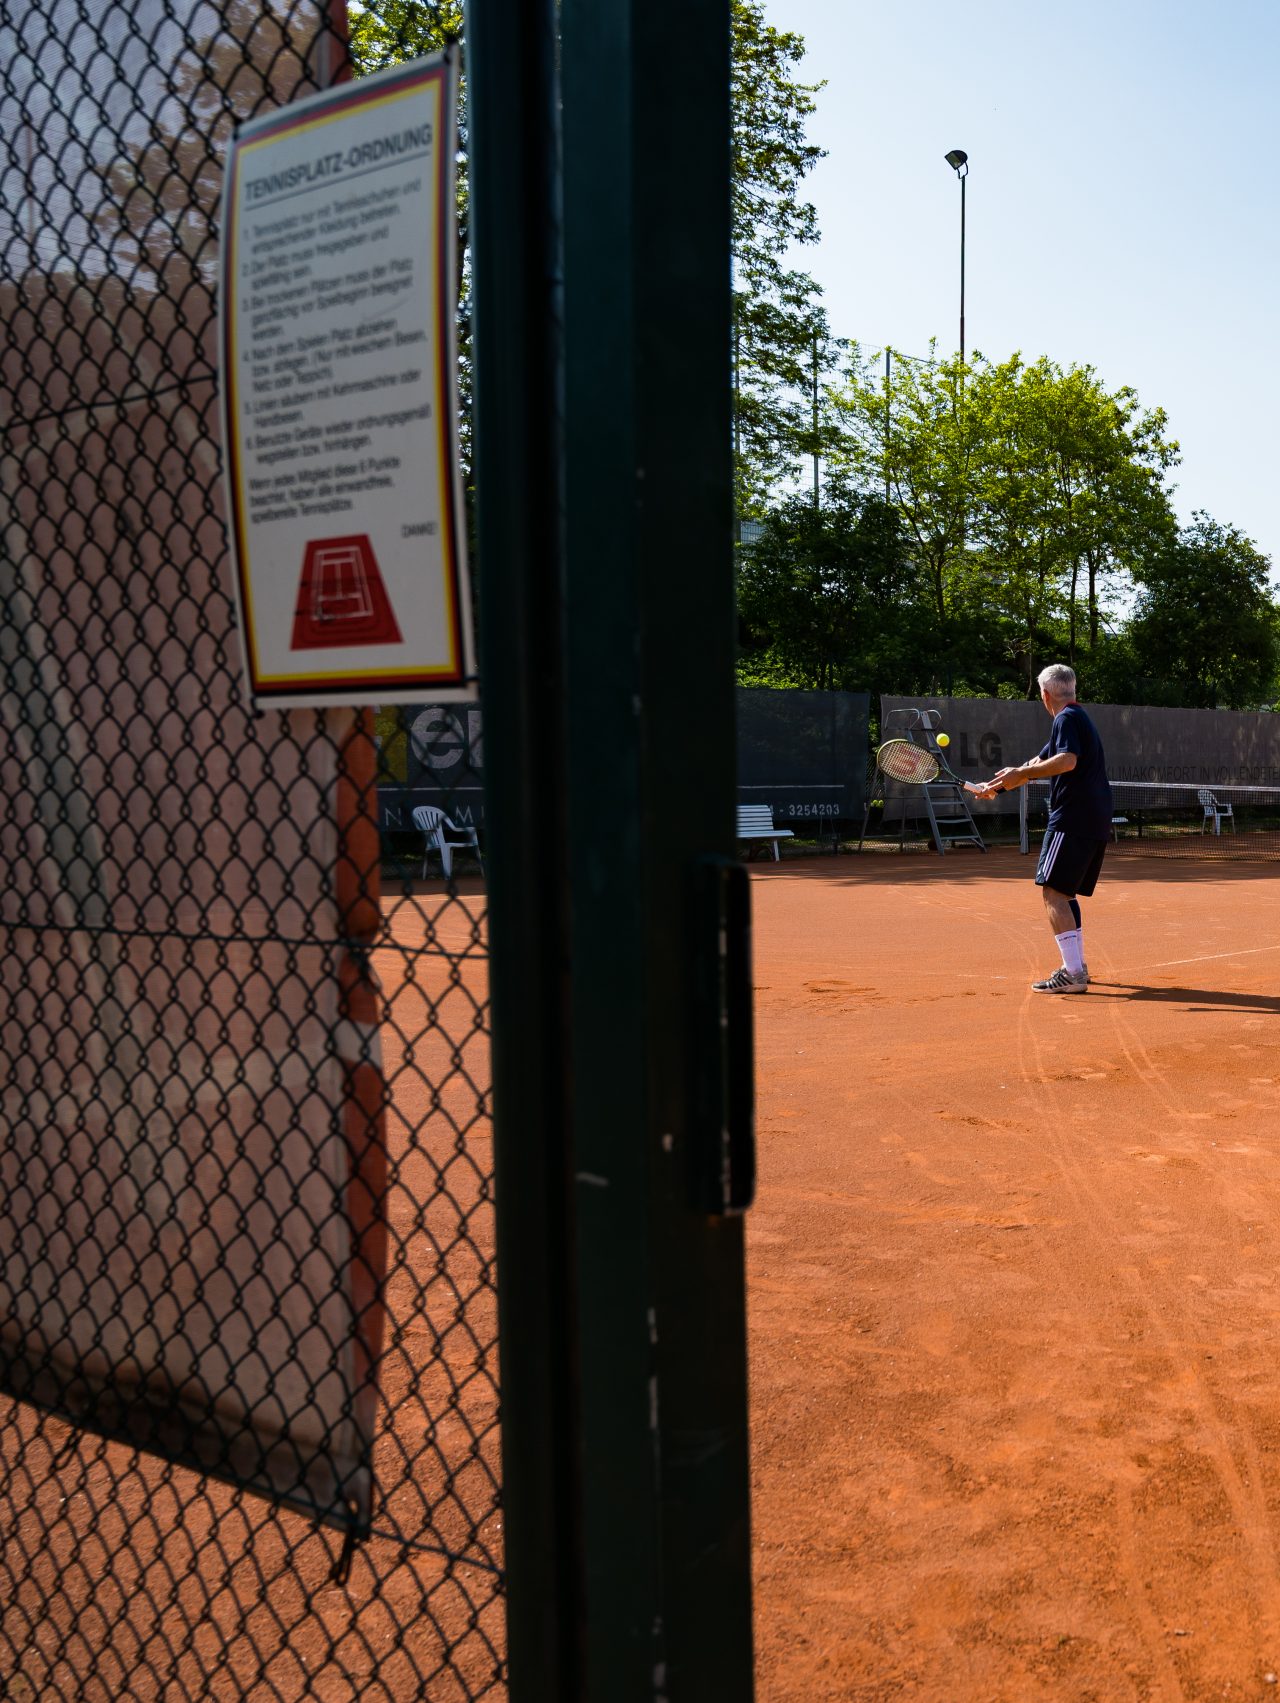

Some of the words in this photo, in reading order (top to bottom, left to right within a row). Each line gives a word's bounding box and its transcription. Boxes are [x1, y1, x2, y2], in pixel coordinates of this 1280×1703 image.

[245, 123, 432, 200] TENNISPLATZ-ORDNUNG
[960, 731, 1003, 767] LG
[788, 803, 840, 817] 3254203
